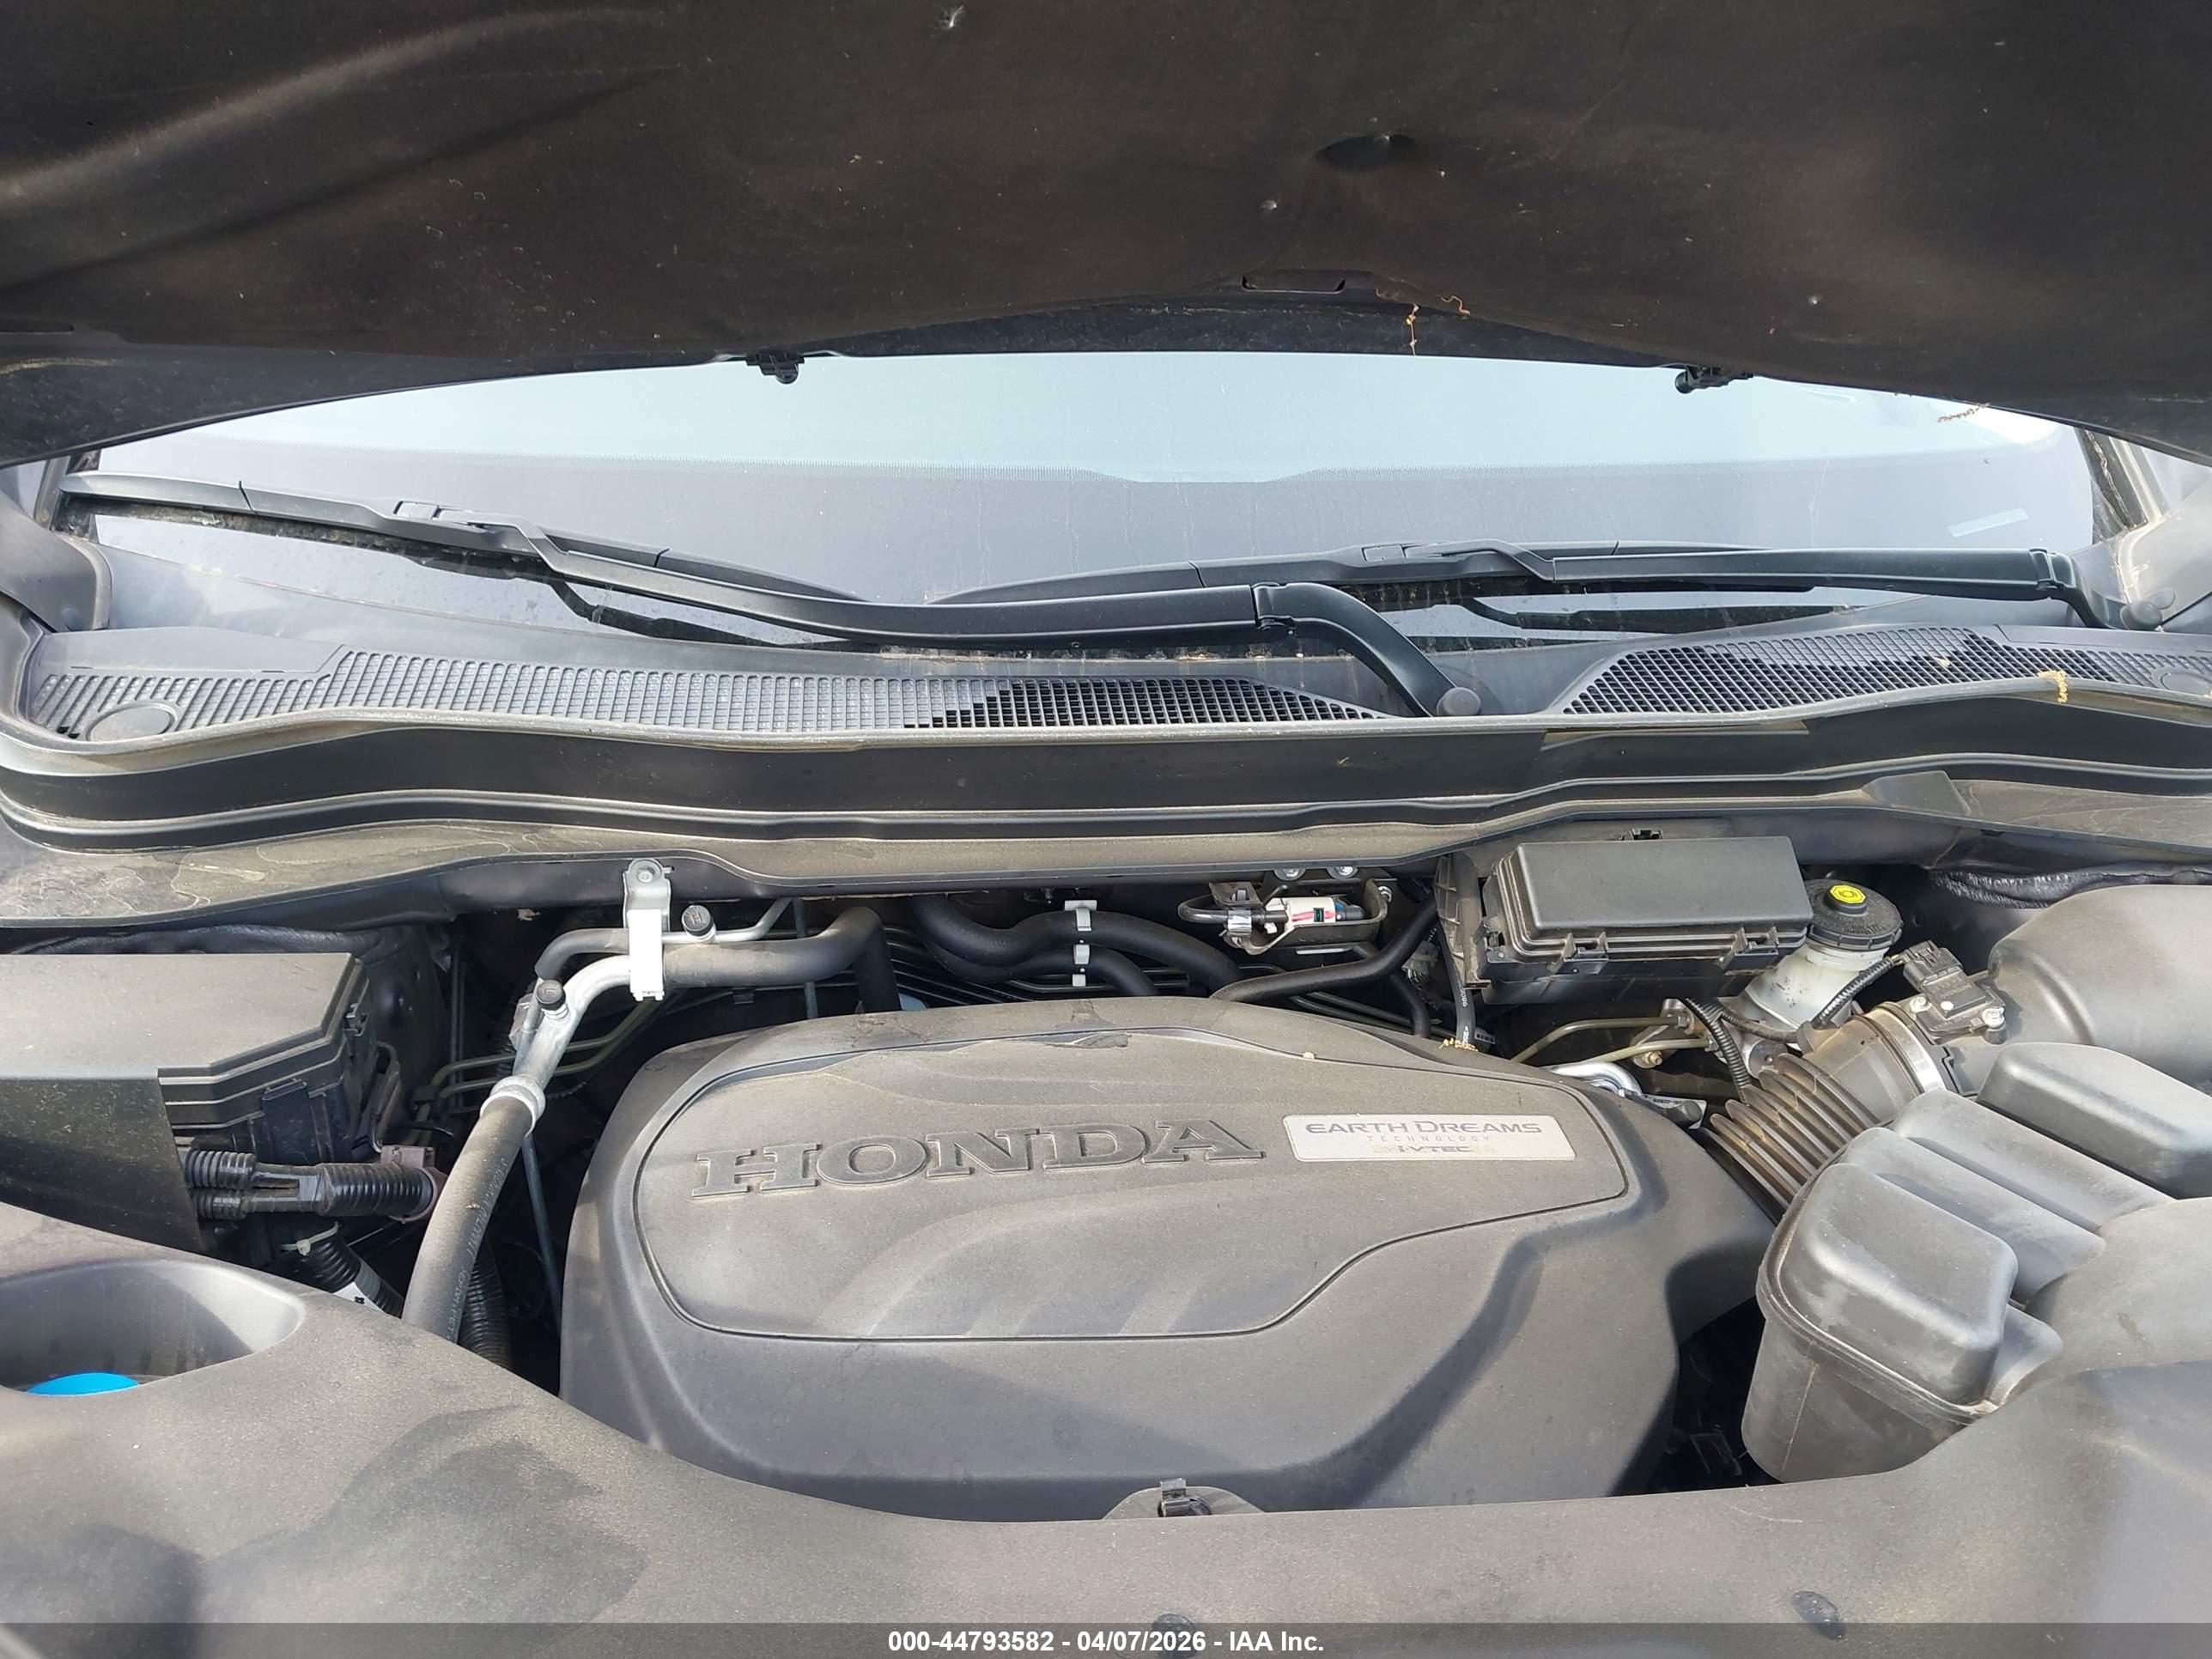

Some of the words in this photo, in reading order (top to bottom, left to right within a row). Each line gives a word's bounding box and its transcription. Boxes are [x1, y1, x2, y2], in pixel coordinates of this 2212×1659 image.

[1305, 1122, 1409, 1133] EARTH
[1413, 1121, 1542, 1133] DREAMS
[691, 1119, 1266, 1199] HONDA
